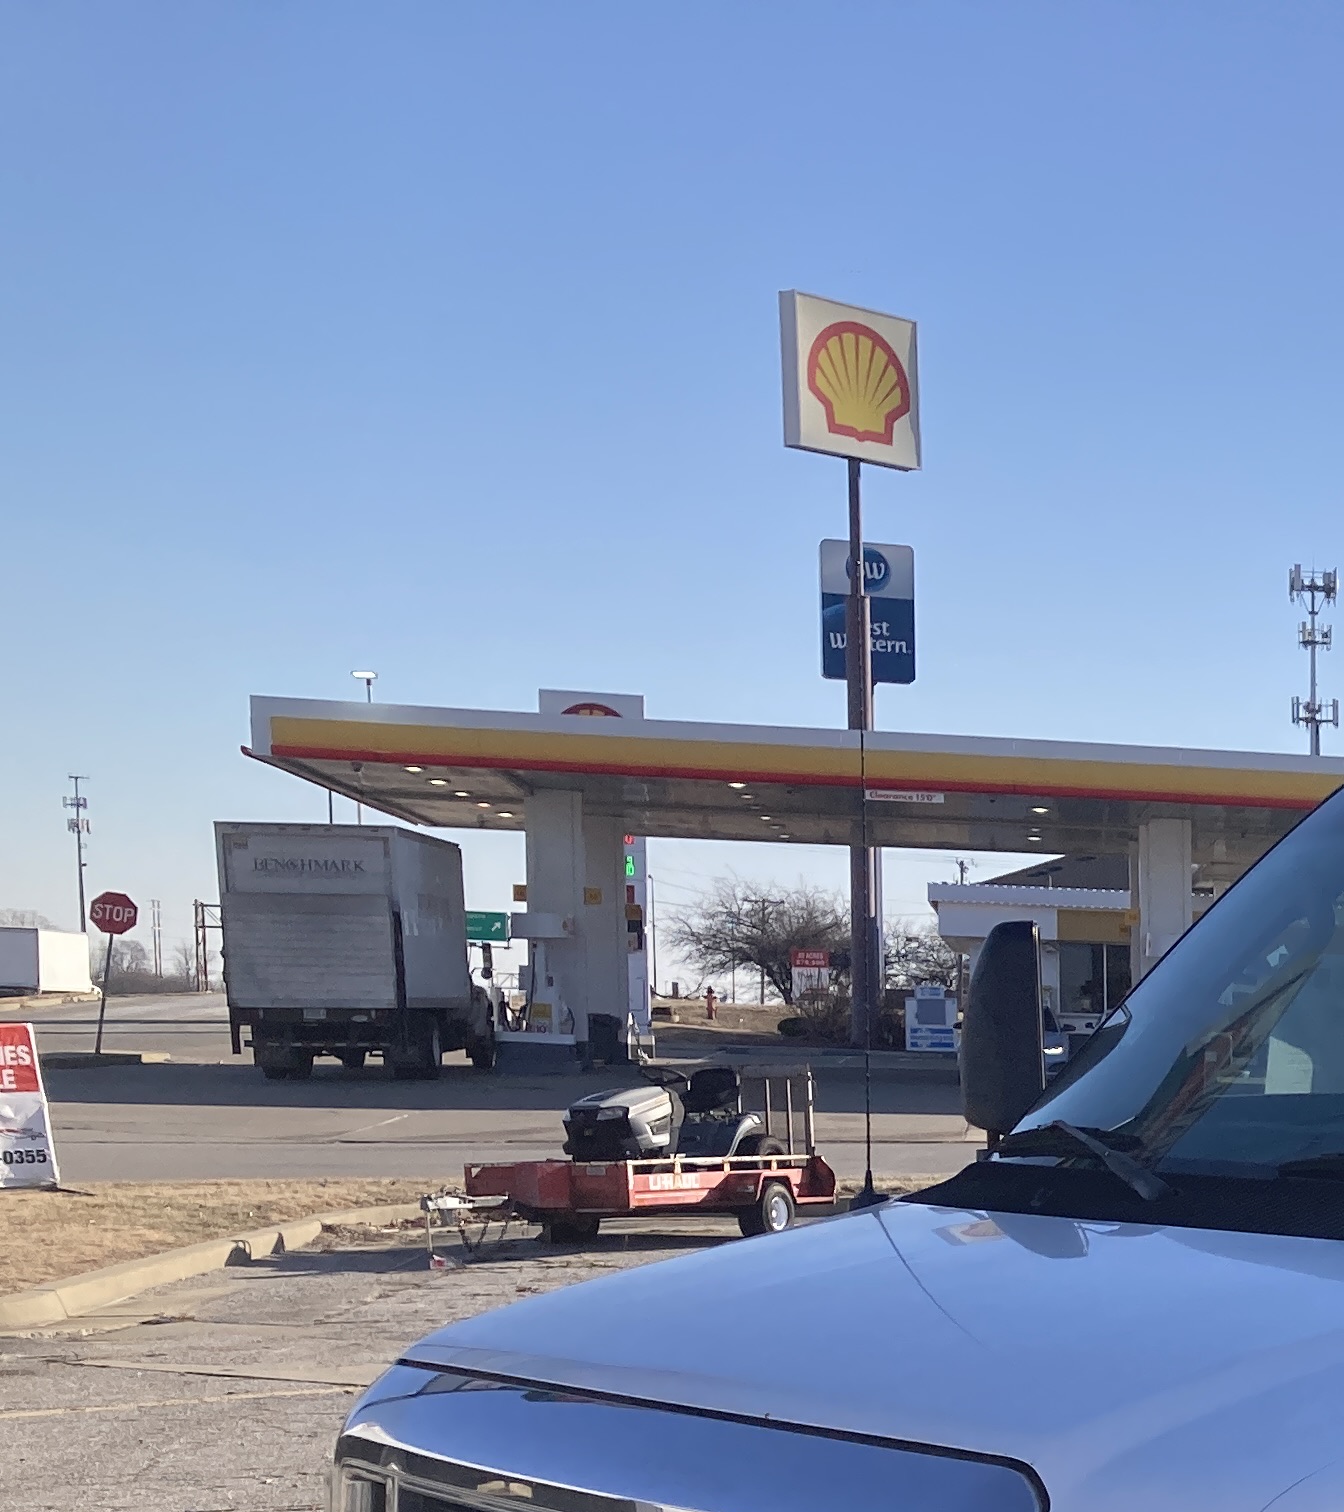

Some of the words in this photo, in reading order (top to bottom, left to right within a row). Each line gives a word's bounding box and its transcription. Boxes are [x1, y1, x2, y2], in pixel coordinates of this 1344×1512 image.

[864, 561, 886, 580] W
[870, 621, 890, 636] st
[829, 632, 907, 654] Wtern
[869, 790, 914, 801] Clearance
[253, 857, 366, 873] BENCHMARK
[91, 903, 136, 923] STOP
[0, 1045, 31, 1066] ES
[0, 1069, 17, 1090] E
[648, 1174, 700, 1191] U-HAUL
